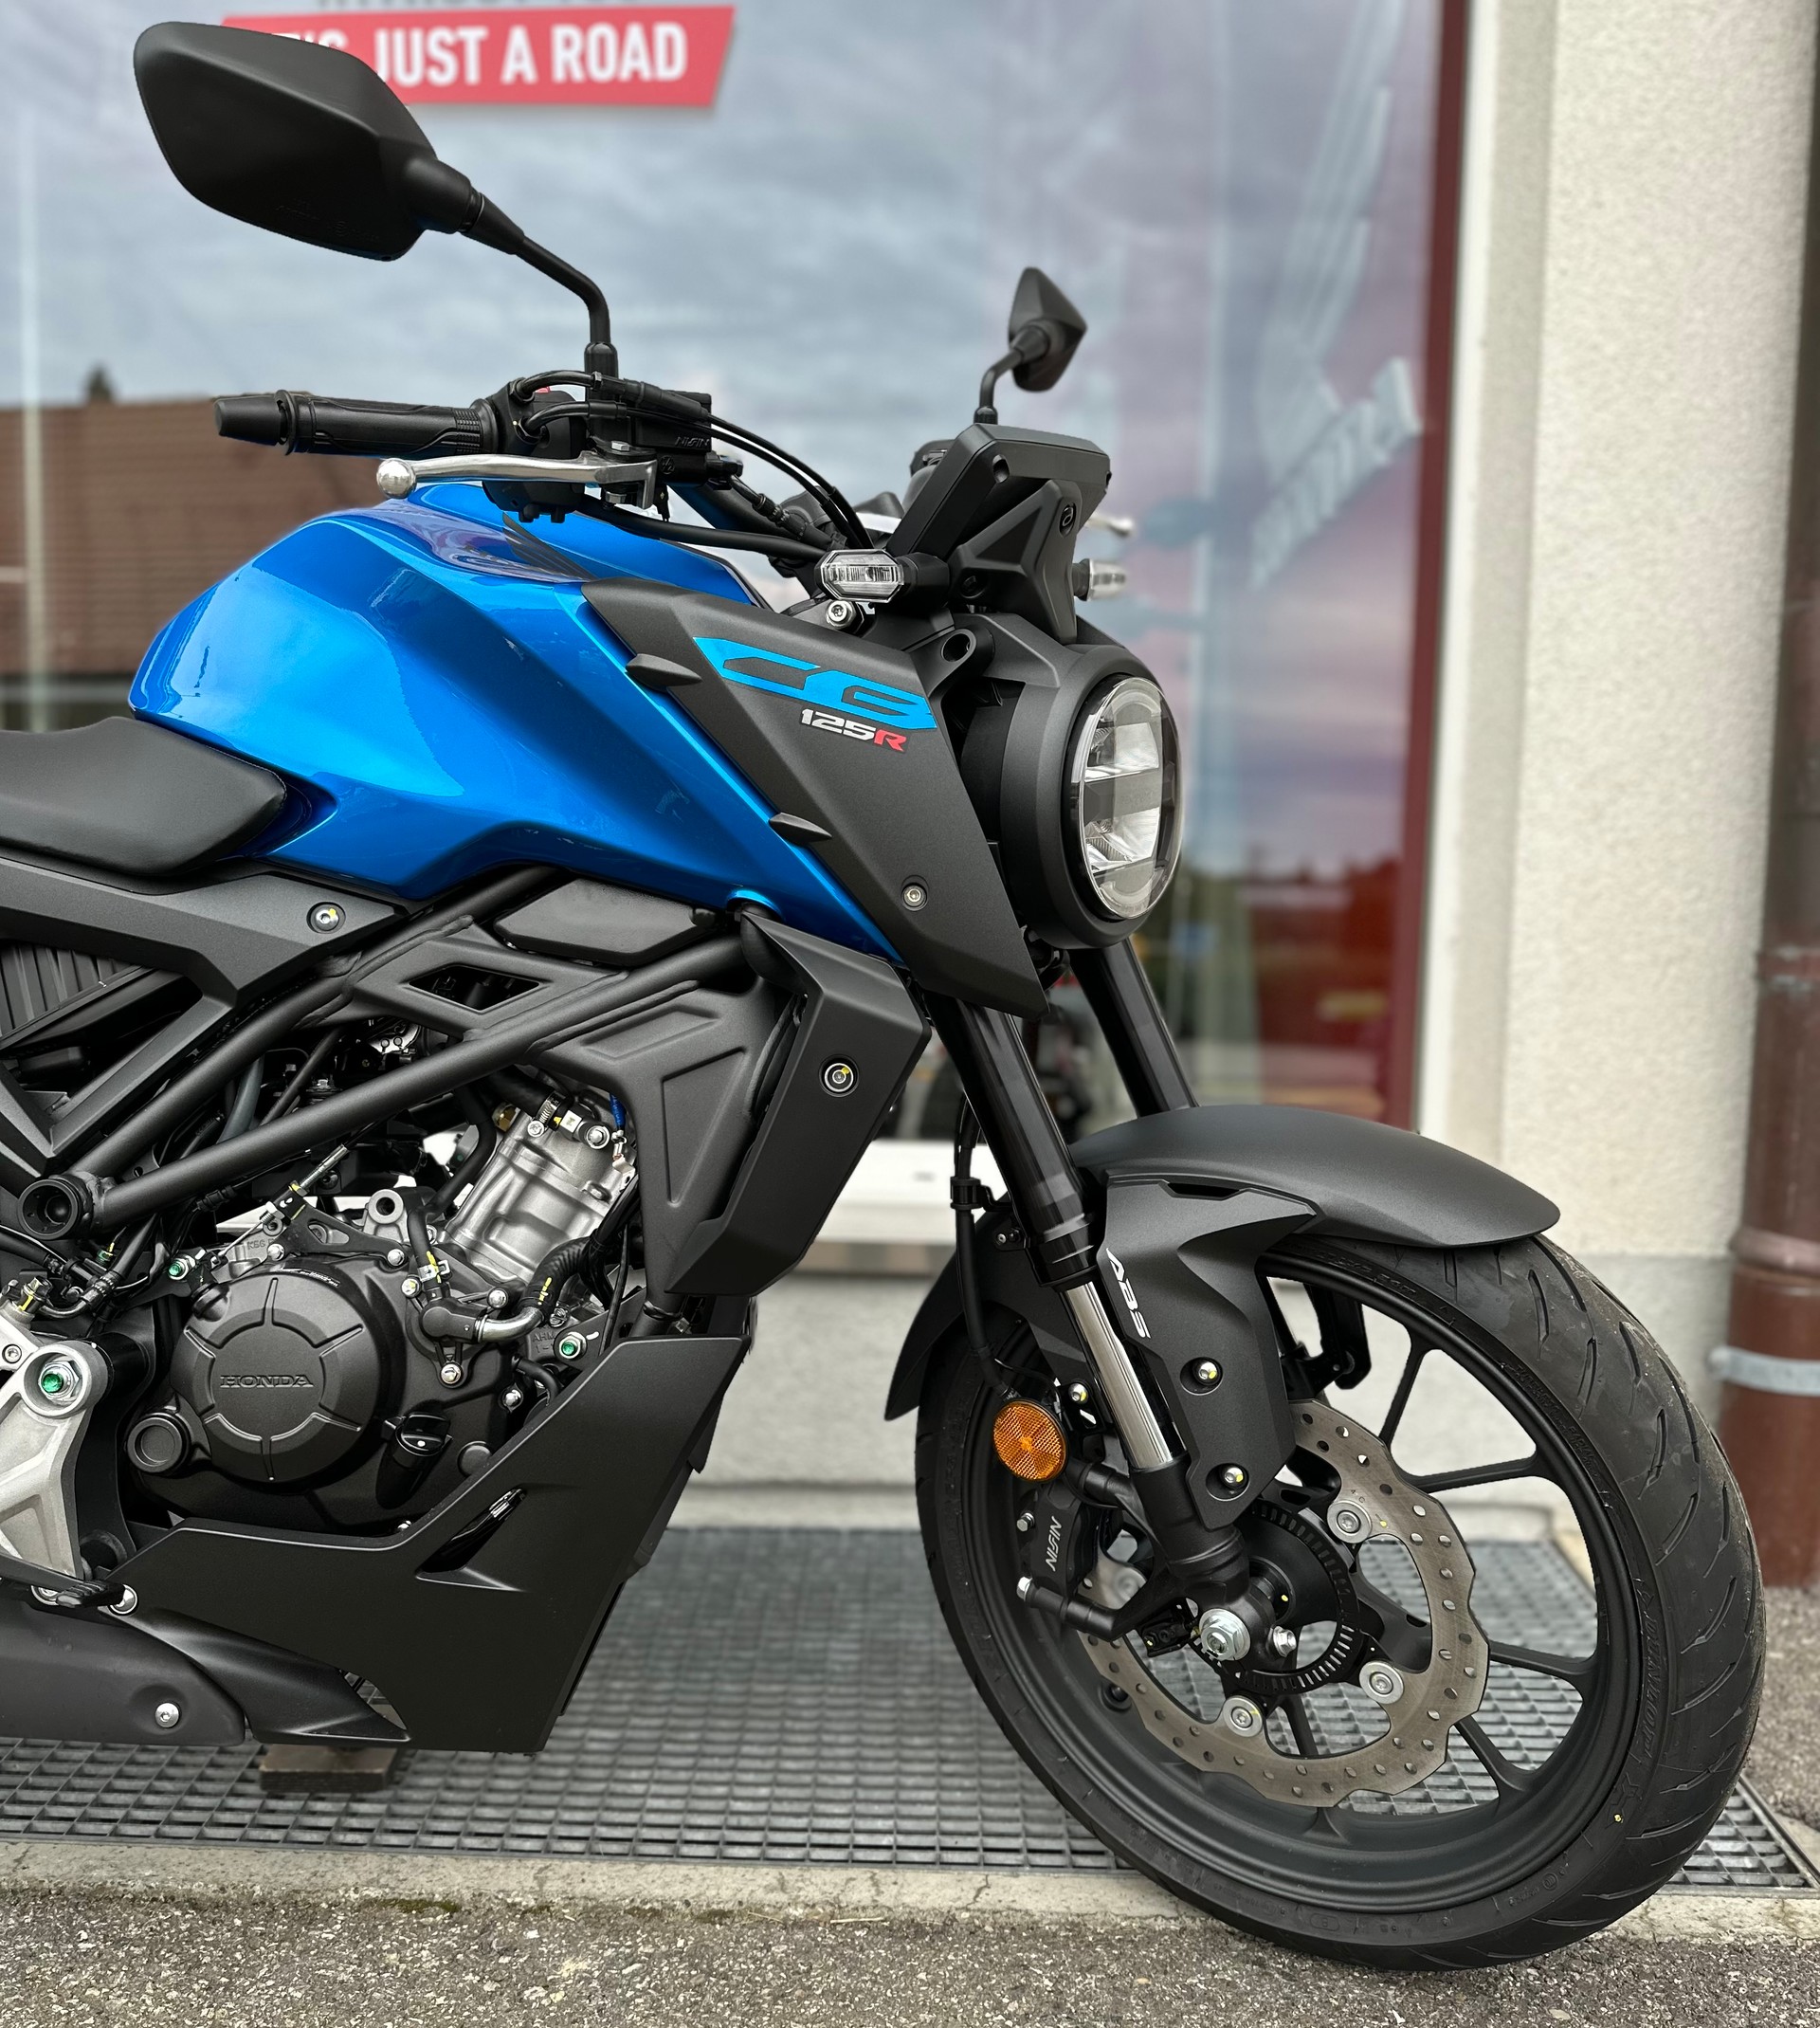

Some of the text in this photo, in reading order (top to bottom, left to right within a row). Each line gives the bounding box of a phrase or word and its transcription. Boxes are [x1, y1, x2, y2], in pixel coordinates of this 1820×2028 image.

[374, 22, 688, 86] JUST A ROAD
[800, 708, 907, 752] 125R
[1106, 1247, 1152, 1339] ABS
[219, 1374, 315, 1389] HONDA
